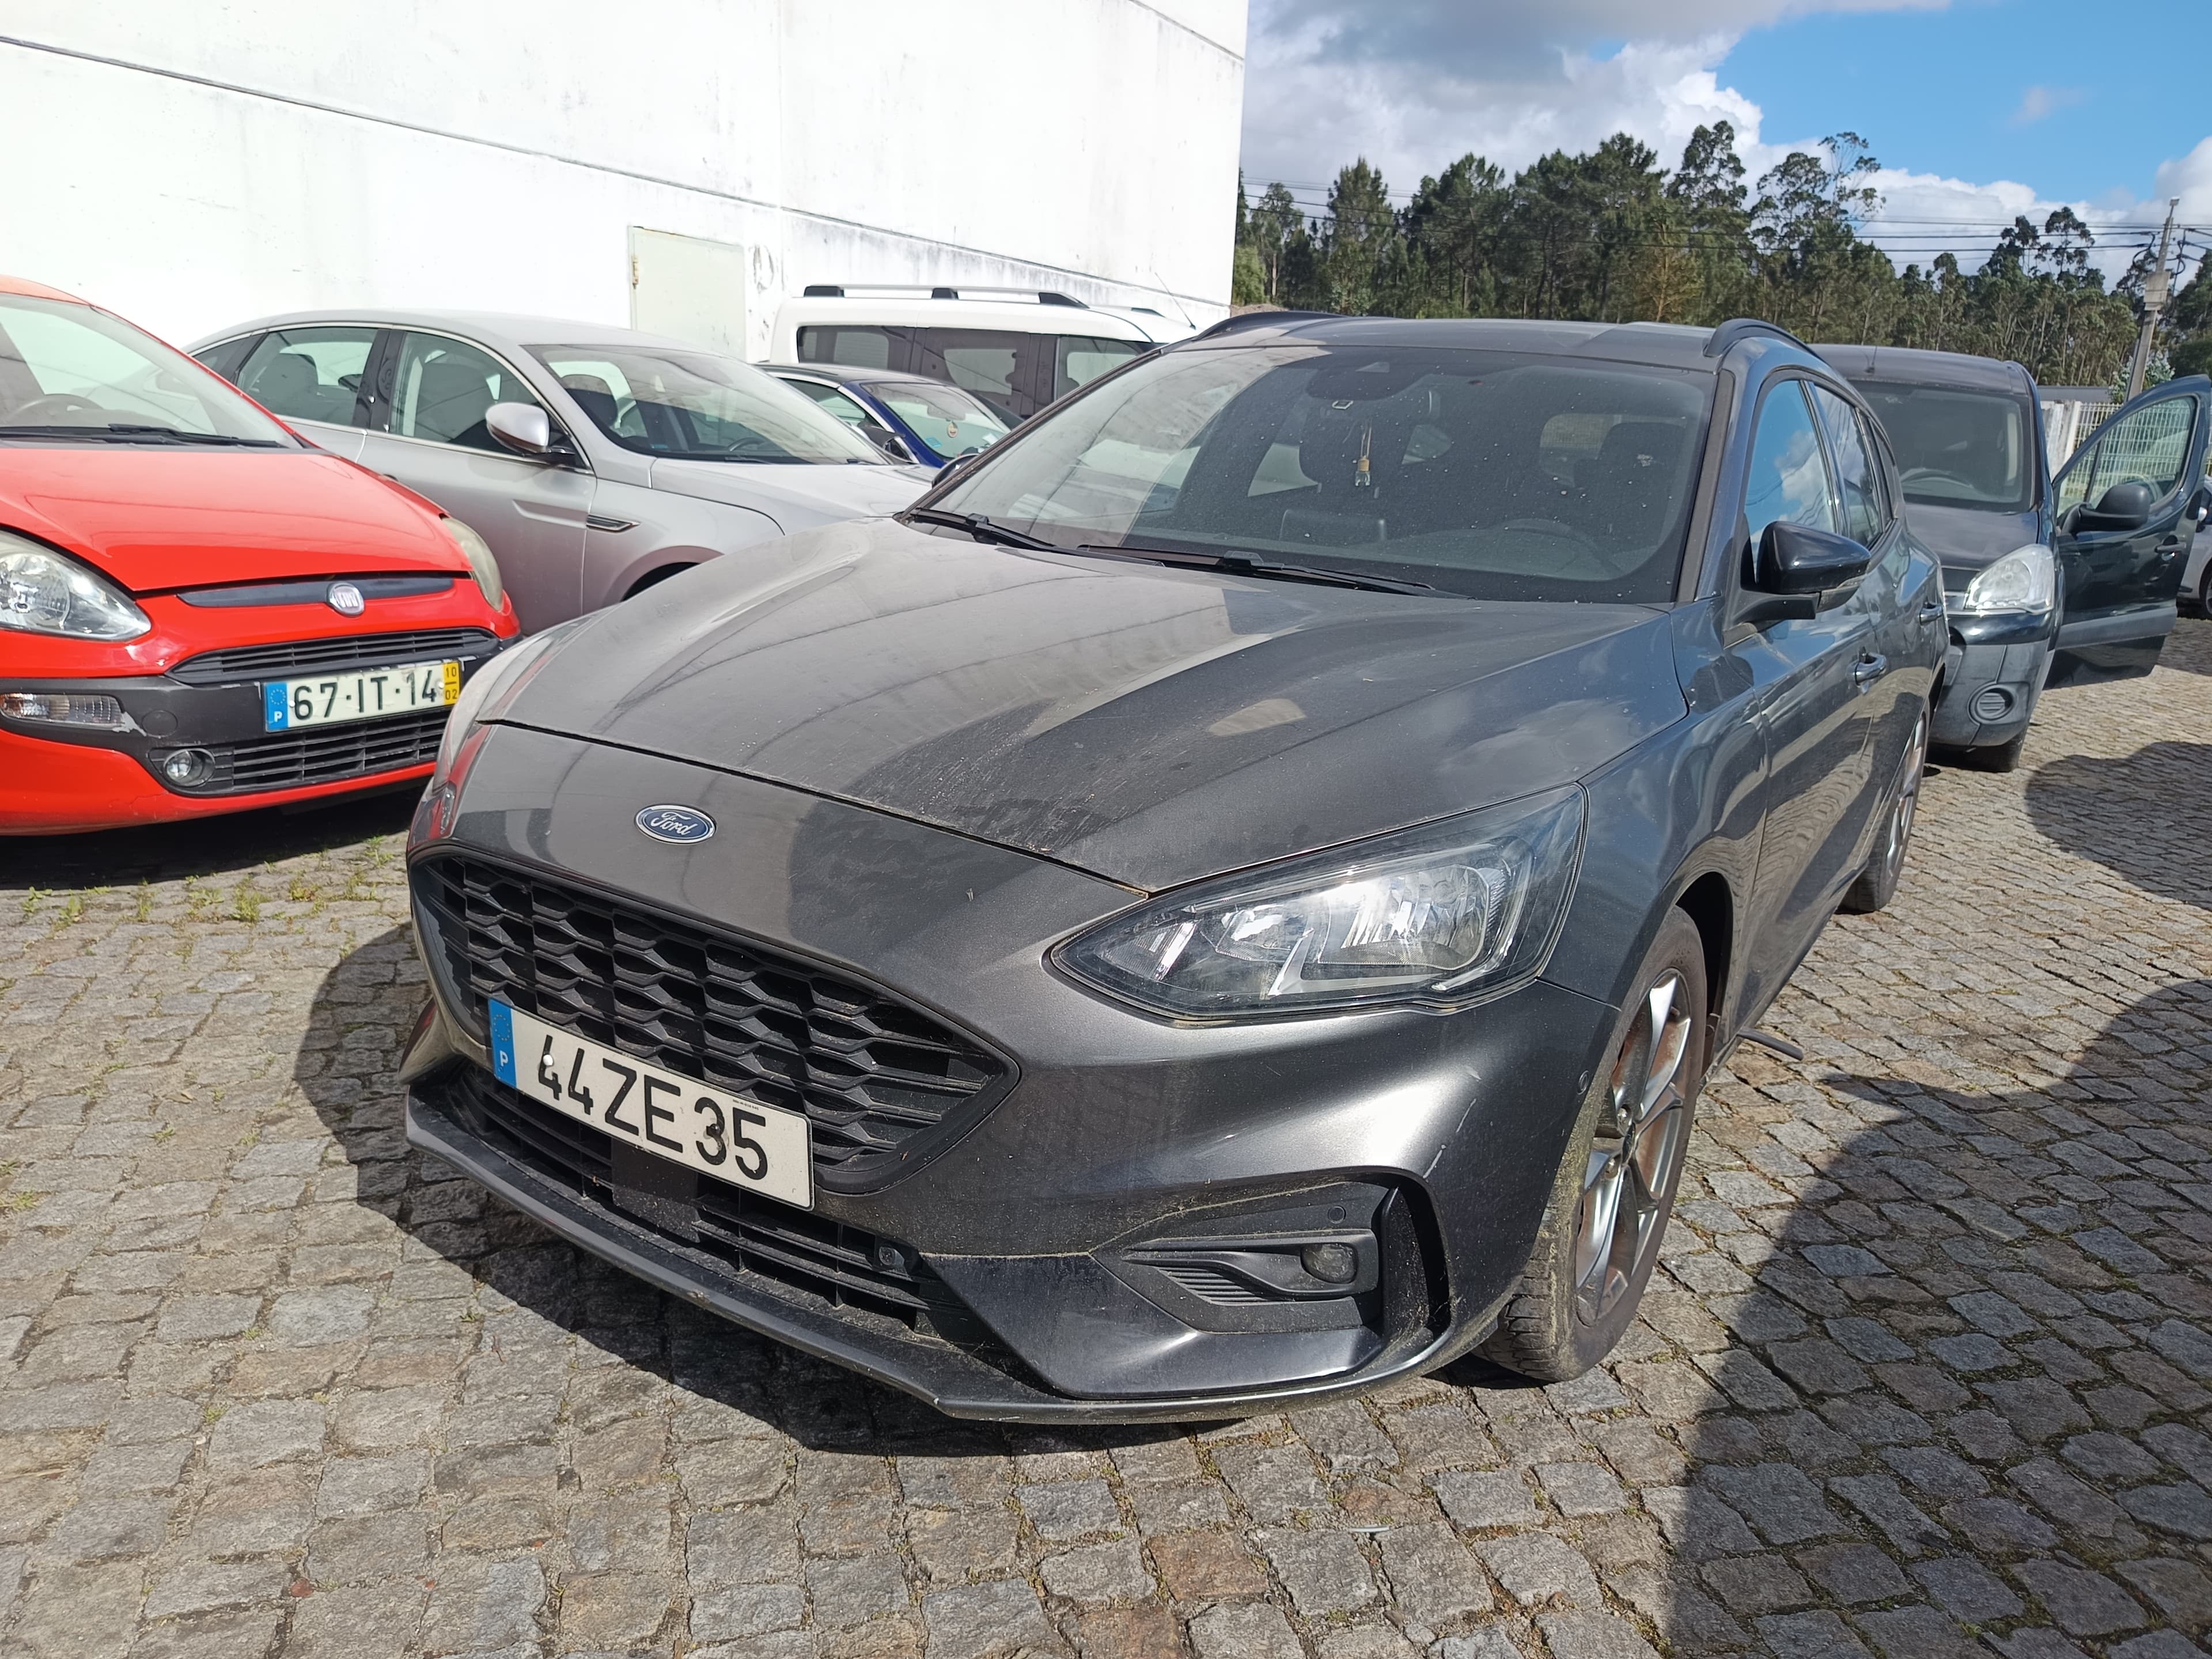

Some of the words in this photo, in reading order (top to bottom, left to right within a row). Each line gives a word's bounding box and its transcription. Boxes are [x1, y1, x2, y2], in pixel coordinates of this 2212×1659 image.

[446, 667, 457, 678] 10
[445, 688, 458, 700] 02
[274, 710, 282, 722] P
[651, 812, 698, 835] Ford
[499, 1050, 509, 1067] P
